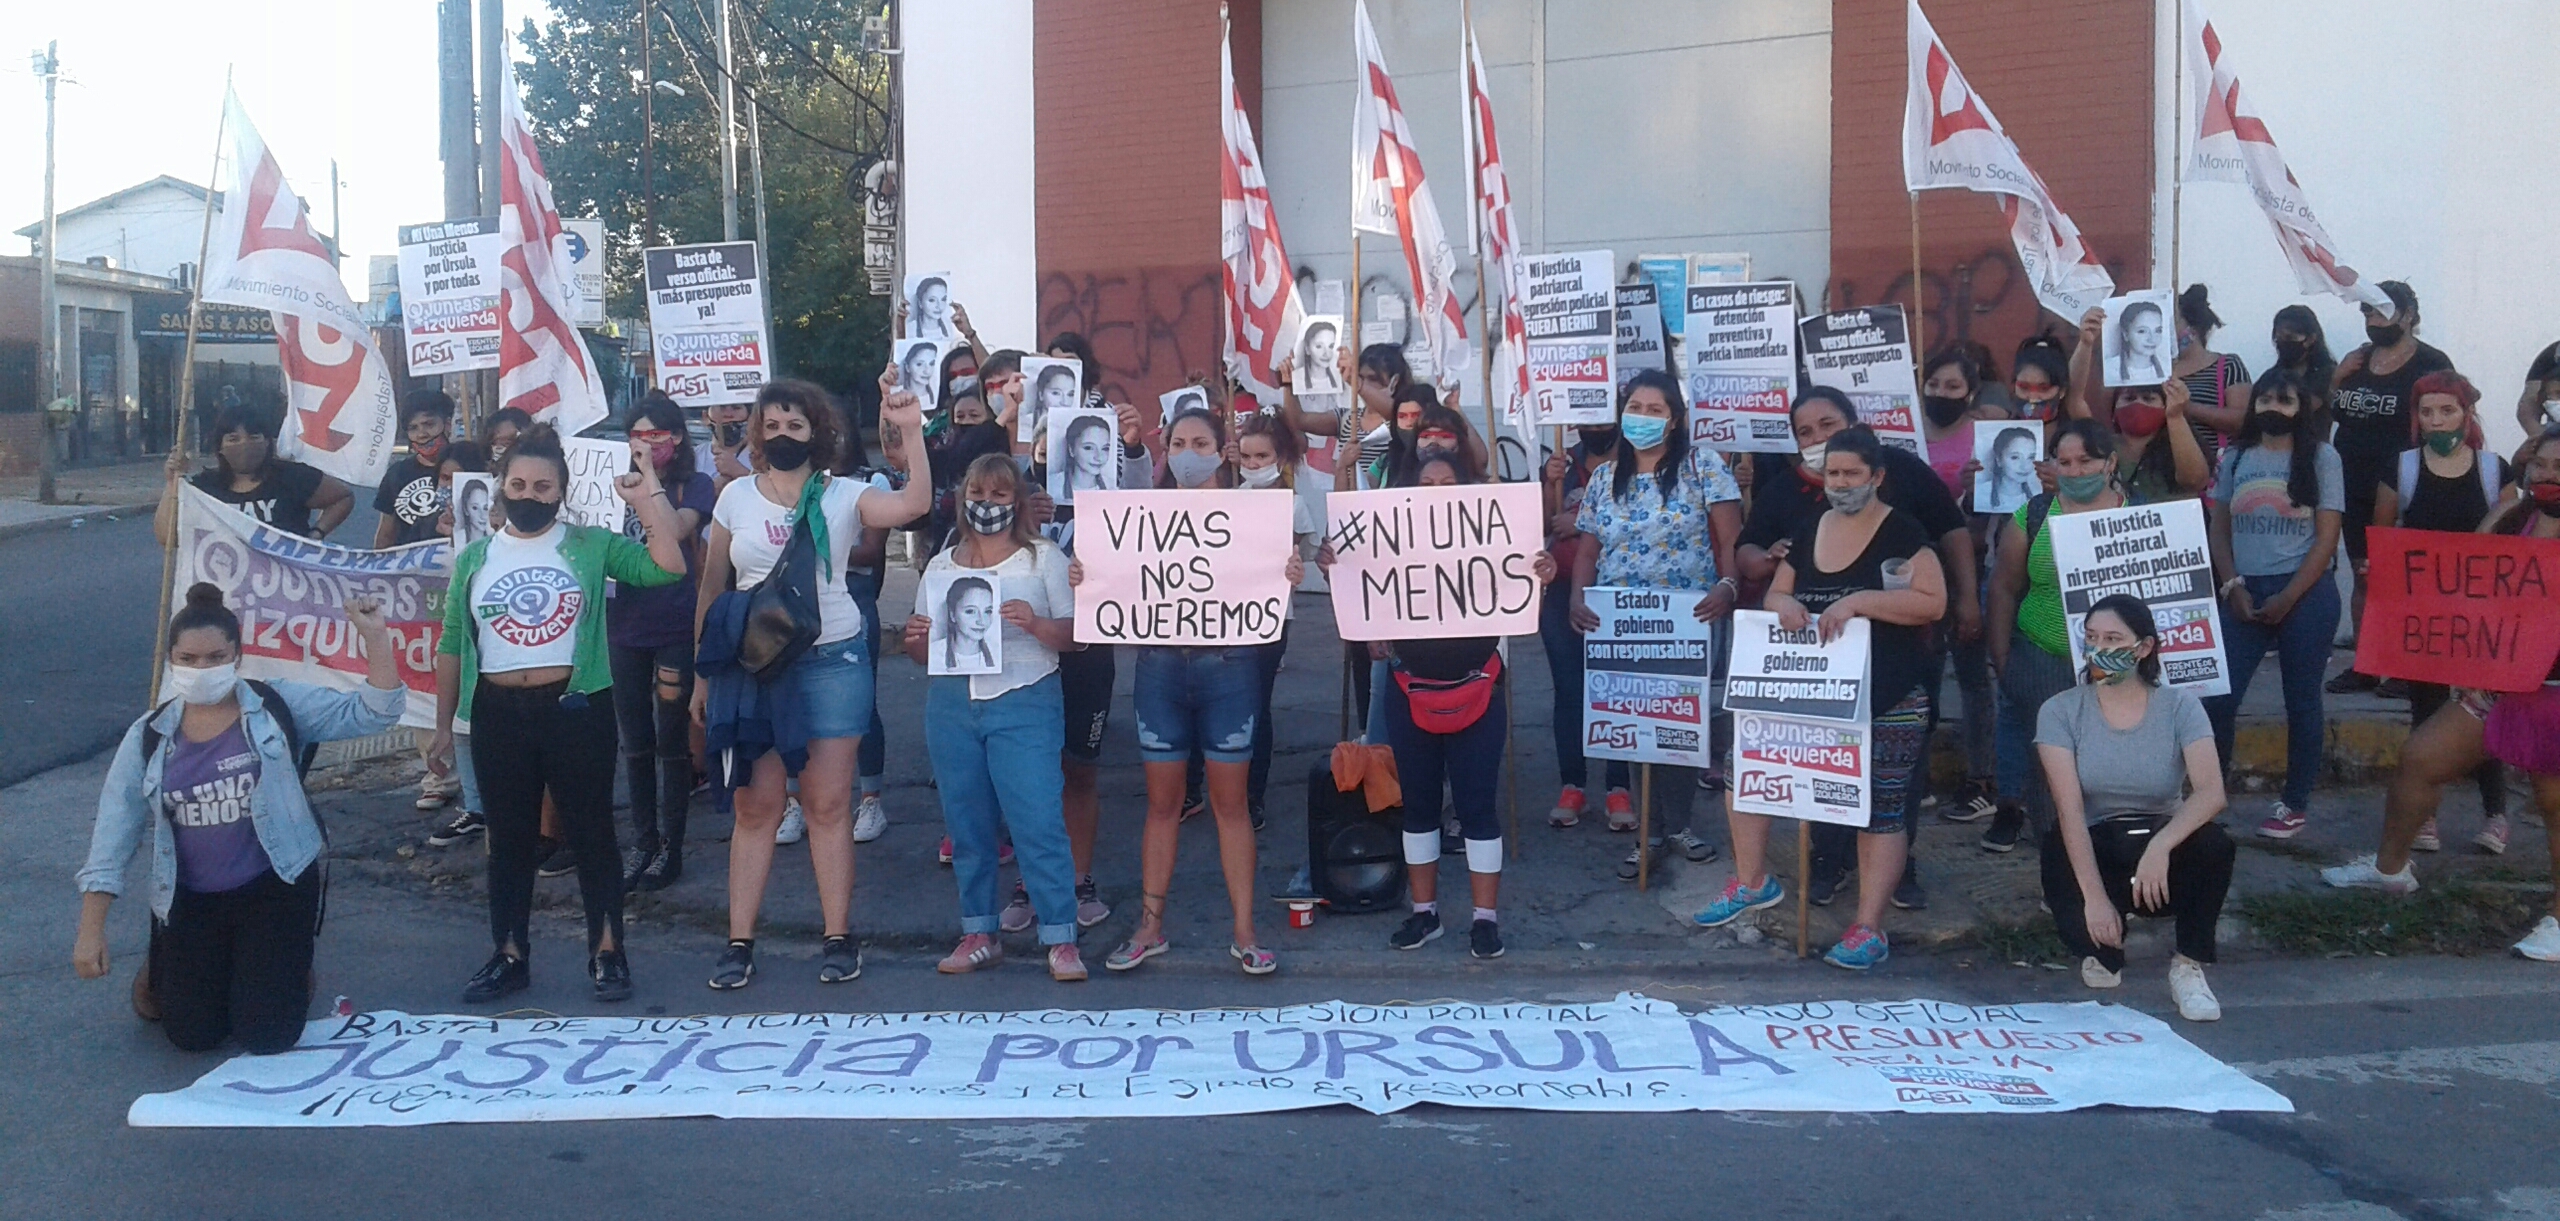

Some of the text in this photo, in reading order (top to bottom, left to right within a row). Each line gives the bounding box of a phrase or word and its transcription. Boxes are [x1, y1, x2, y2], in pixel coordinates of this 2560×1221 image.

[425, 224, 444, 241] Una
[445, 221, 479, 238] Menos
[428, 240, 467, 258] Justicia
[675, 249, 723, 268] Basta de
[423, 256, 476, 278] por Úrsula
[667, 265, 737, 287] verso oficial:
[1529, 258, 1582, 279] Ni justicia
[424, 272, 481, 296] y por todas
[685, 282, 752, 305] presupuesto
[1530, 276, 1583, 300] patriarcal
[1524, 291, 1609, 320] epresión policial
[1692, 287, 1787, 310] En casos de riesgo:
[220, 314, 231, 330] &
[424, 310, 497, 333] izquierda
[697, 303, 715, 320] ya!
[1713, 308, 1765, 328] detención
[1826, 310, 1872, 331] Basta de
[1527, 318, 1558, 337] FUERA
[1559, 313, 1598, 333] BERNI!
[1708, 327, 1773, 347] preventiva y
[1820, 327, 1886, 350] verso oficial:
[413, 341, 454, 364] MST
[678, 346, 755, 367] izquierda
[1697, 343, 1788, 365] pericia inmediata
[1839, 347, 1902, 369] presupuesto
[1532, 360, 1602, 380] zquierda
[1851, 369, 1869, 387] ya!
[666, 374, 709, 396] MST
[1708, 391, 1784, 410] izquierda
[1856, 395, 1891, 410] ntas
[1694, 418, 1736, 442] MST
[226, 499, 277, 522] AY
[1430, 498, 1513, 549] UNA
[2090, 510, 2163, 538] Ni justicia
[2234, 514, 2308, 537] UNSHINE
[2094, 531, 2168, 563] patriarcal
[1141, 556, 1215, 600] NOS
[2066, 546, 2206, 587] ni represión policial
[2405, 551, 2547, 598] FUERA
[1362, 553, 1535, 622] MENOS
[2141, 573, 2193, 599] BERNI!
[1614, 590, 1670, 613] Estado y
[495, 593, 580, 644] izquierda
[1096, 598, 1281, 640] QUEREMOS
[1614, 617, 1674, 637] gobierno
[1768, 624, 1817, 645] Estado
[1588, 640, 1705, 663] son responsables
[1762, 651, 1829, 674] gobierno
[1729, 679, 1856, 702] son responsables
[1608, 692, 1695, 716] izquierda
[1589, 722, 1637, 748] MST
[1760, 739, 1854, 768] izquierda
[192, 772, 254, 803] UNA
[1743, 772, 1792, 800] MST
[330, 1014, 498, 1041] BASTA
[529, 1018, 590, 1033] DE
[610, 1012, 830, 1034] JUSTICIA
[1156, 1003, 1408, 1027] REPRESION
[1429, 1005, 1608, 1023] POLICIAL
[1856, 1002, 2042, 1024] OFICIAL
[976, 1033, 1194, 1082] por
[1767, 1024, 2143, 1052] PRESUPUESTO
